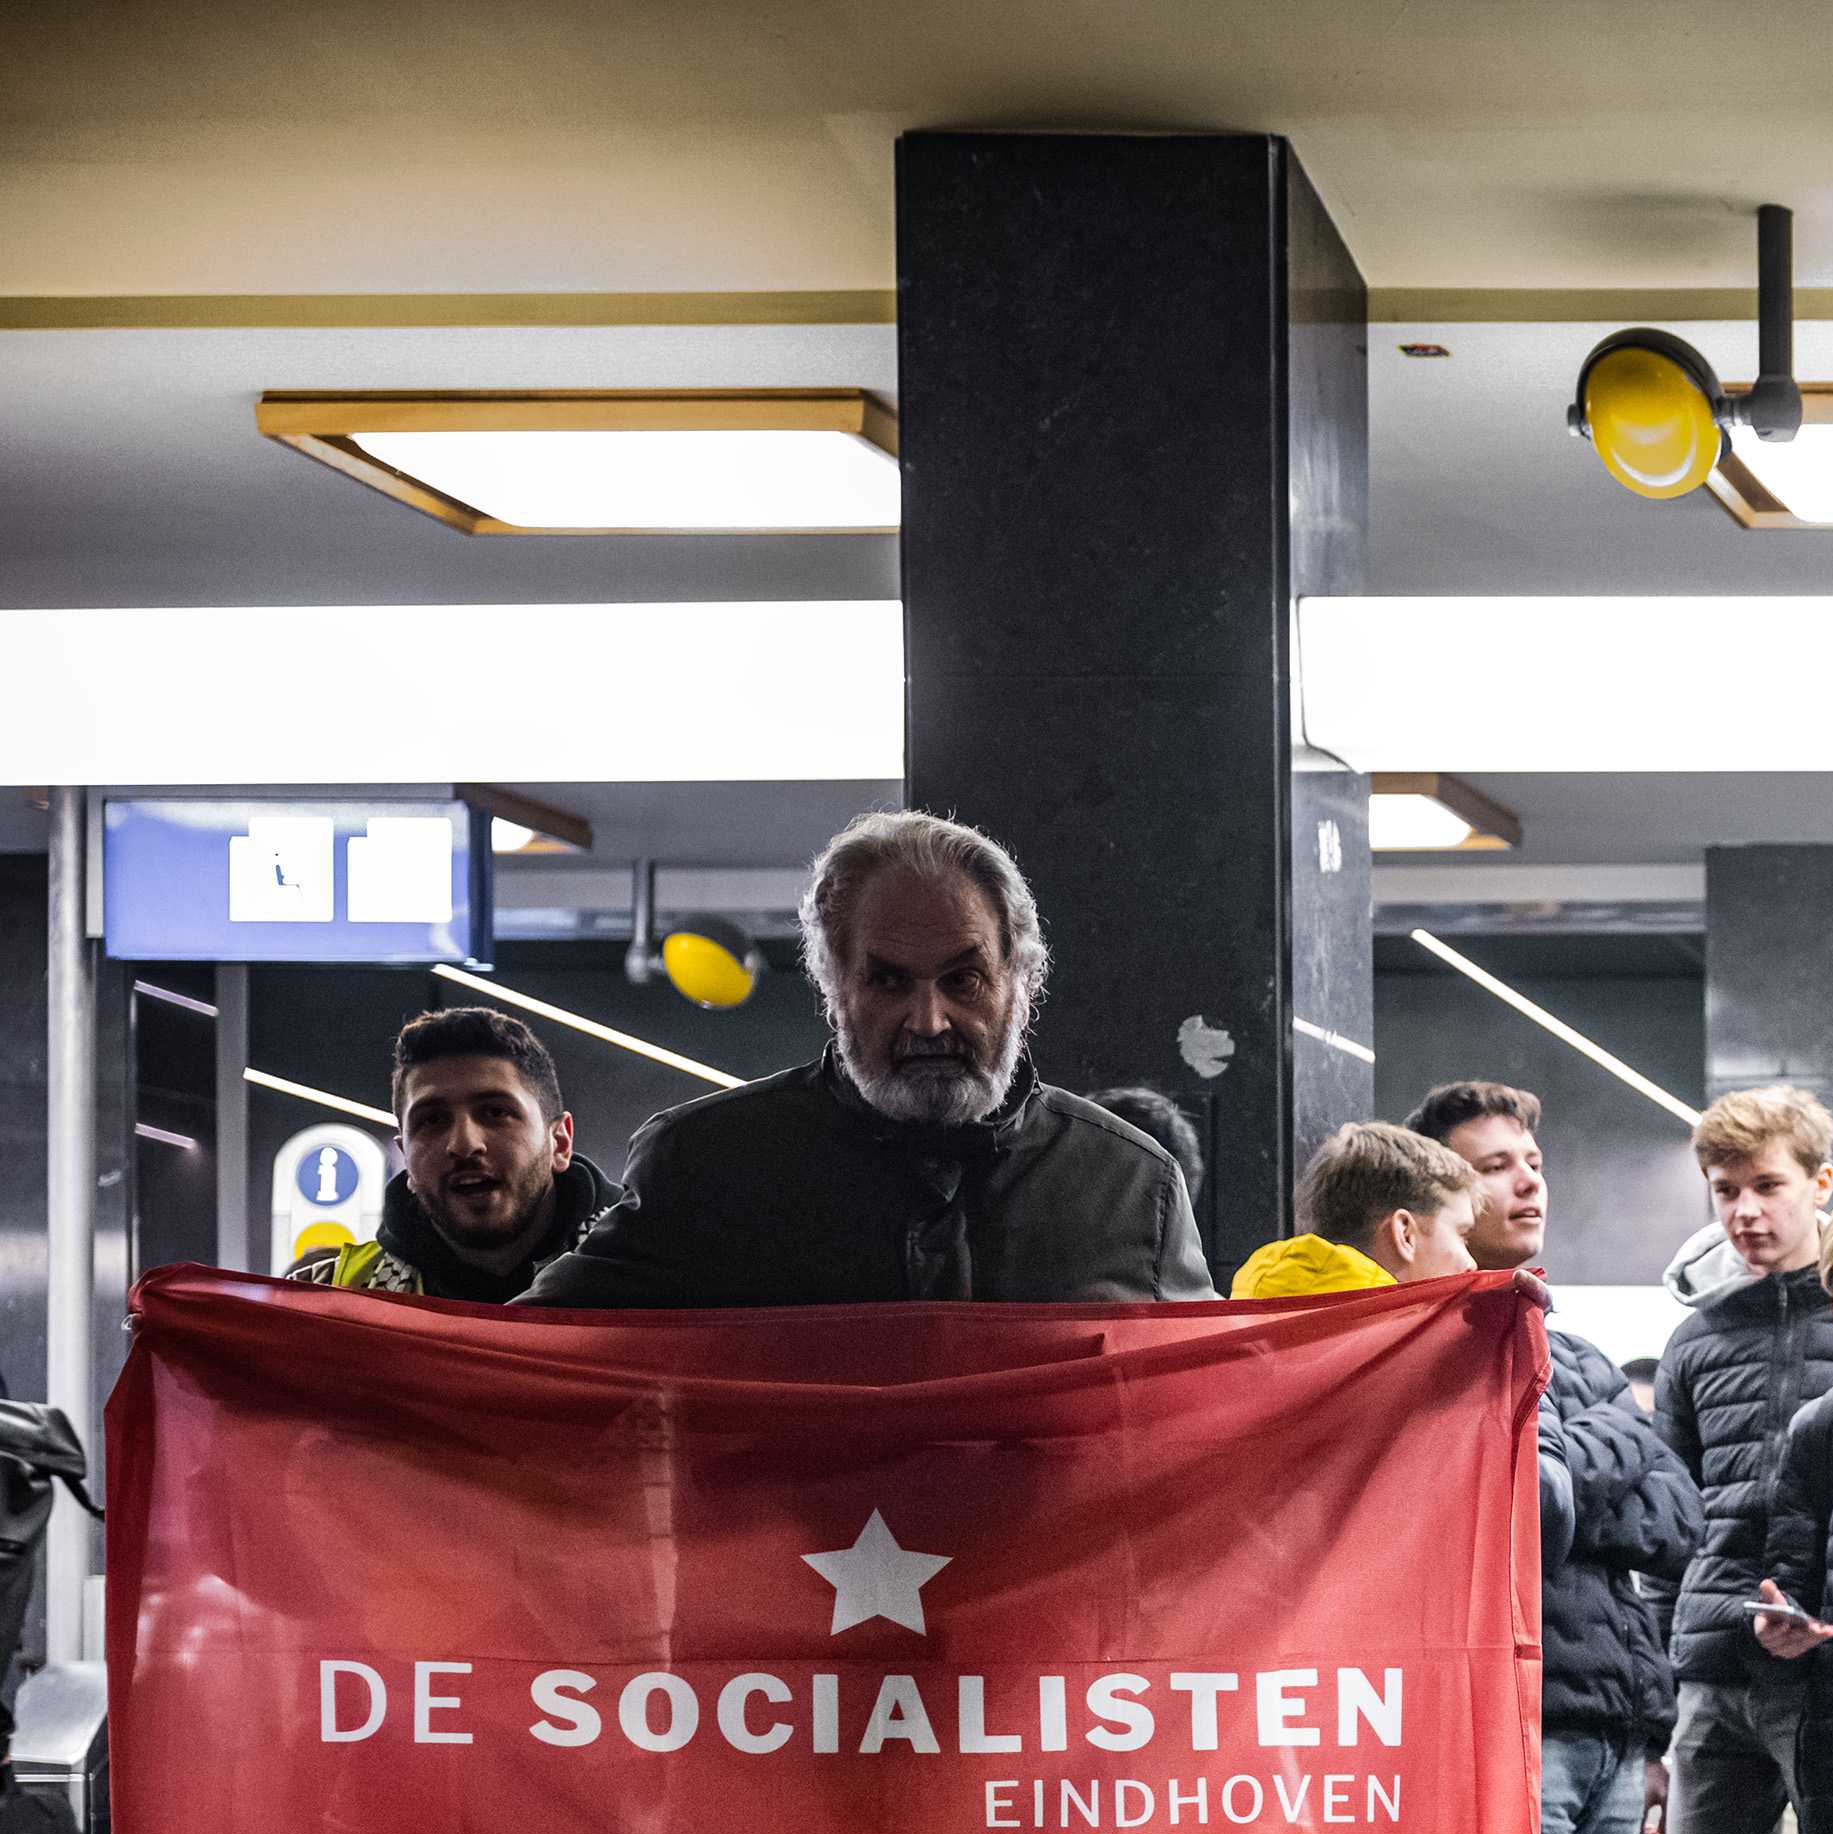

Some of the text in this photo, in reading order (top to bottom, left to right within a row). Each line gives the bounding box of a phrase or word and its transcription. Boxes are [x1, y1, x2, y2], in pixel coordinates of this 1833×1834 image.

[319, 1660, 1403, 1755] DE SOCIALISTEN
[985, 1772, 1403, 1830] EINDHOVEN
